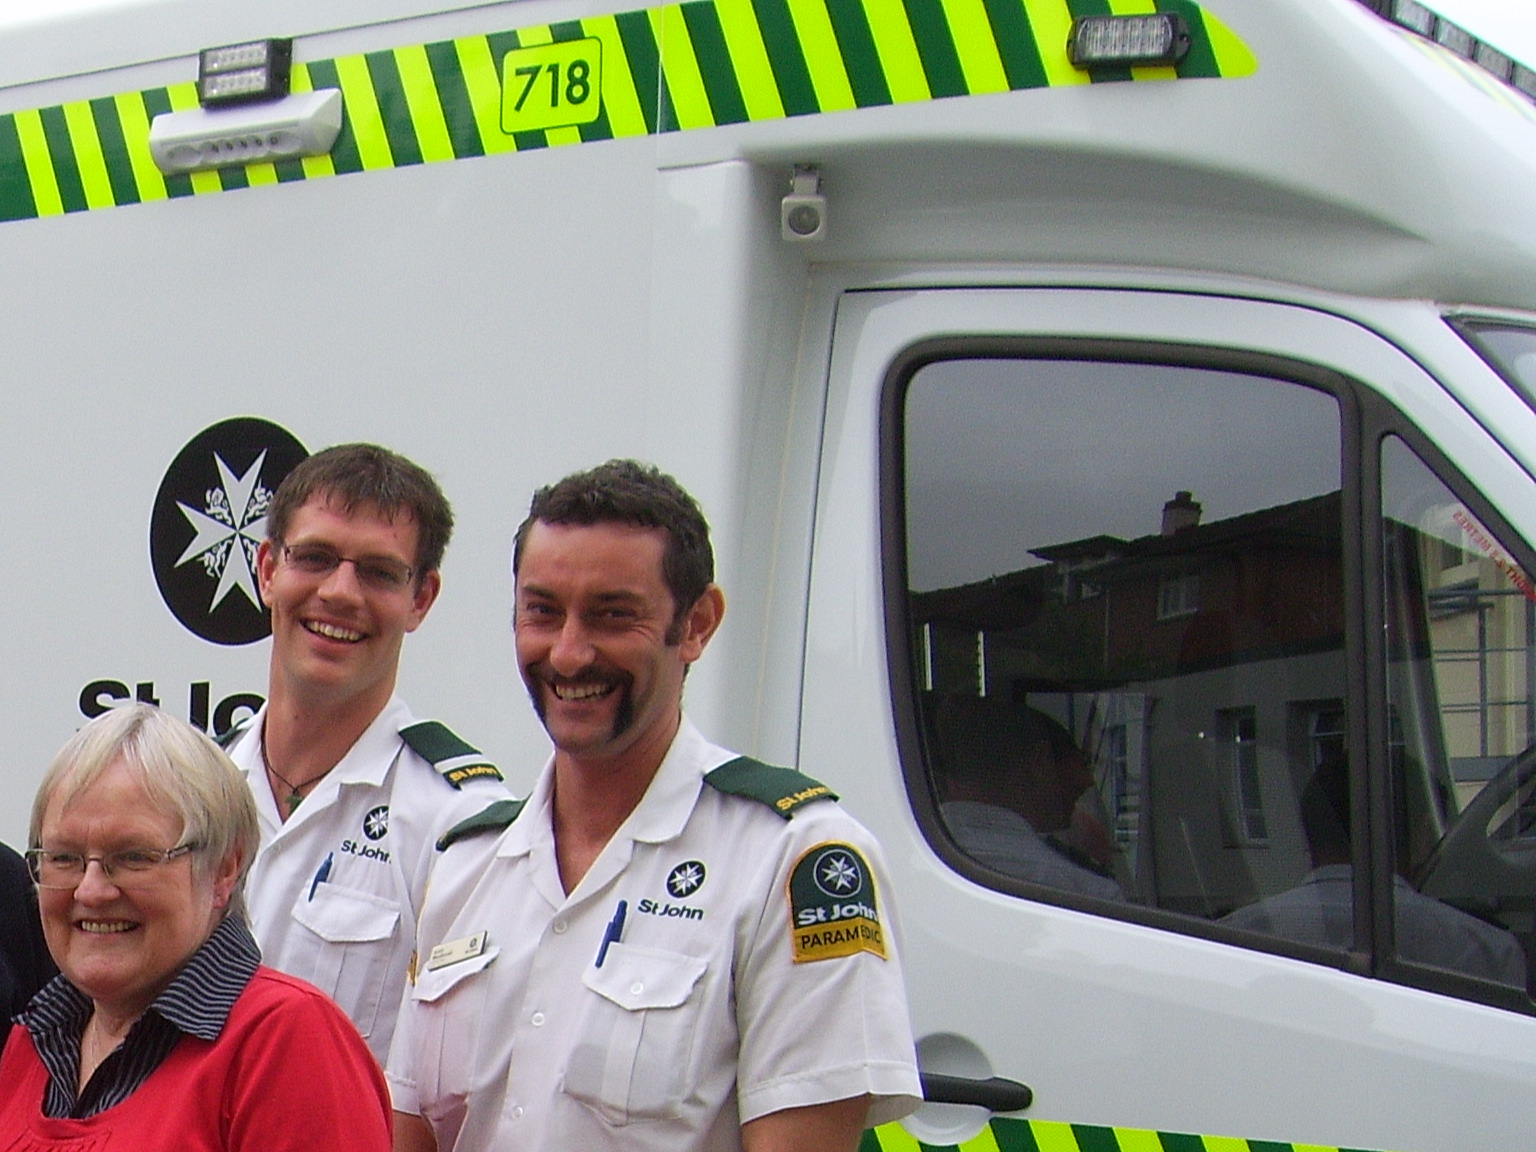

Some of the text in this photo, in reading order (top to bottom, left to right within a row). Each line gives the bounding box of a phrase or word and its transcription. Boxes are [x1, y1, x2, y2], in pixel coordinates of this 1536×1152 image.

[513, 58, 591, 113] 718
[189, 681, 269, 740] Jo
[341, 840, 357, 855] St
[638, 899, 704, 921] St John
[798, 901, 879, 926] St John
[801, 926, 881, 949] PARAMEDIC
